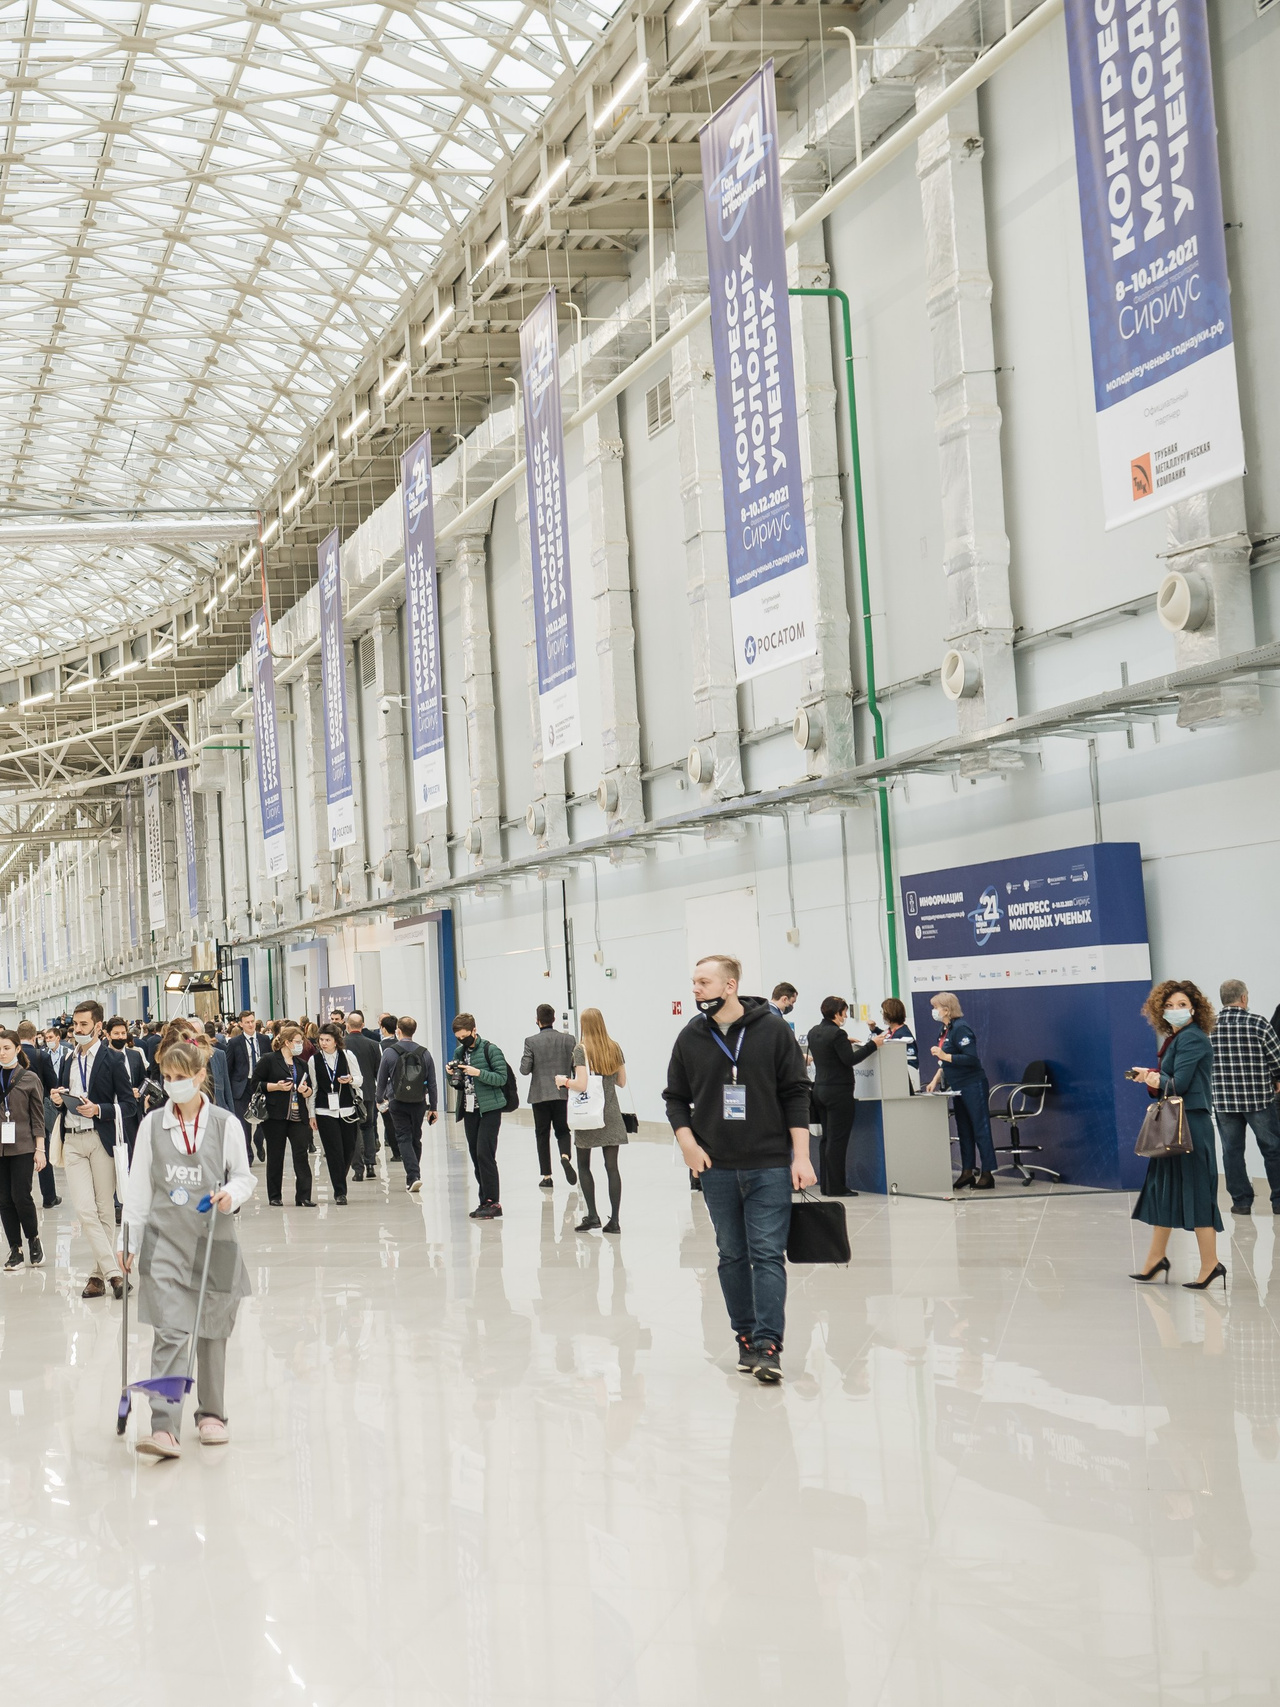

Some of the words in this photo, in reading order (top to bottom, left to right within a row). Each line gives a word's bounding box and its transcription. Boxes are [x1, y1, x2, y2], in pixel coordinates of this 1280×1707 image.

[720, 174, 735, 193] Год
[721, 181, 743, 207] науки
[1119, 273, 1202, 340] Сириус
[724, 269, 752, 494] КОНГРЕСС
[739, 245, 768, 485] МОЛОДЫХ
[759, 279, 787, 477] УЧЕНЫХ
[1105, 318, 1225, 393] молодыеученые.годнауки.рф
[1153, 442, 1179, 462] ТРУБНАЯ
[1155, 441, 1211, 475] МЕТАЛЛУРГИЧЕСКАЯ
[1156, 466, 1187, 489] КОМПАНИЯ
[534, 444, 550, 613] КОНГРЕСС
[541, 425, 558, 609] МОЛОДЫХ
[551, 454, 567, 606] УЧЕНЫХ
[742, 510, 792, 551] Сириус
[409, 552, 423, 695] КОНГРЕСС
[416, 540, 430, 692] МОЛОДЫХ
[425, 566, 437, 689] УЧЕНЫХ
[757, 620, 806, 655] РОСАТОМ
[919, 891, 964, 908] ИНФОРМАЦИЯ
[1007, 899, 1051, 917] КОНГРЕСС
[1009, 914, 1053, 931] МОЛОДЫХ
[1053, 909, 1093, 927] УЧЕНЫХ
